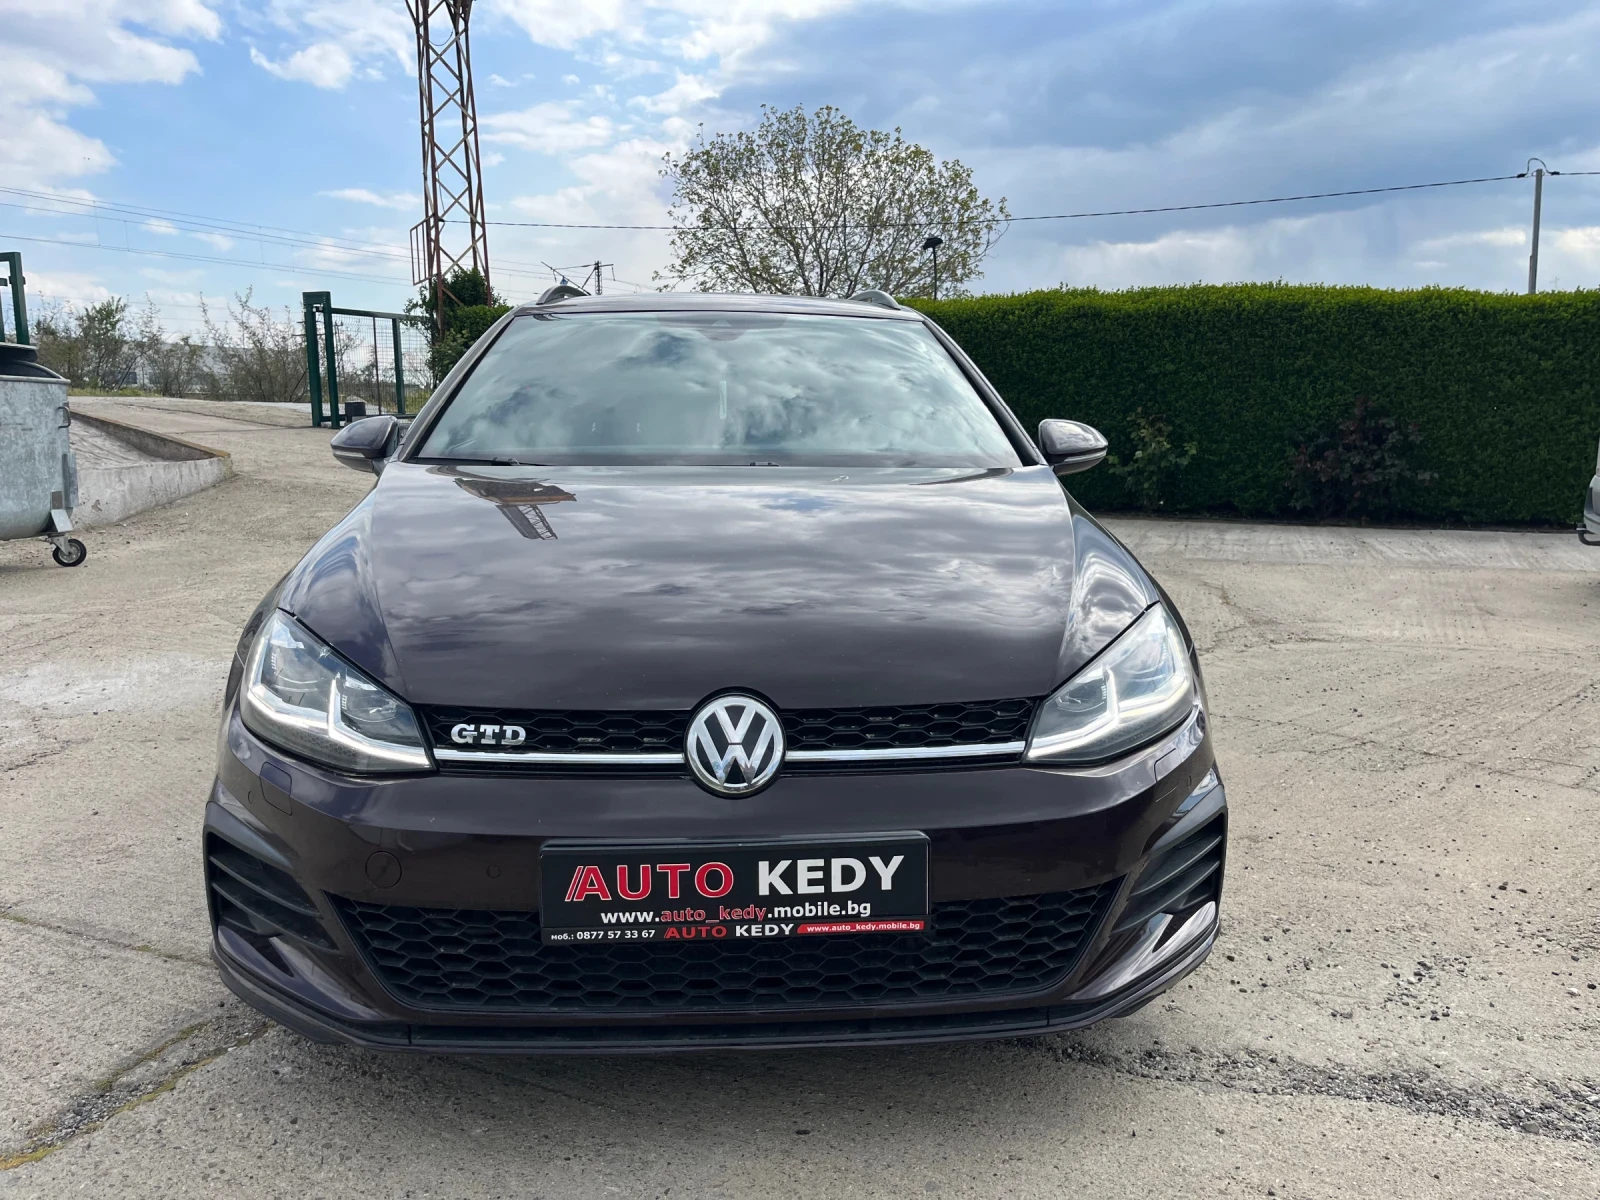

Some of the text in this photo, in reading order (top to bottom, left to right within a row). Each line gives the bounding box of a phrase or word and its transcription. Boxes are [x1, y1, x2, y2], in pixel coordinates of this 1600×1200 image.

[451, 724, 526, 745] GTD
[564, 855, 904, 902] AUTO KEDY
[601, 901, 871, 924] www.auto_kedy.mobile.bg
[607, 931, 621, 939] 57
[625, 930, 638, 938] 33
[641, 930, 655, 938] 67
[664, 922, 920, 938] AUTO KEDY www.auto_kedy.mobile.bg
